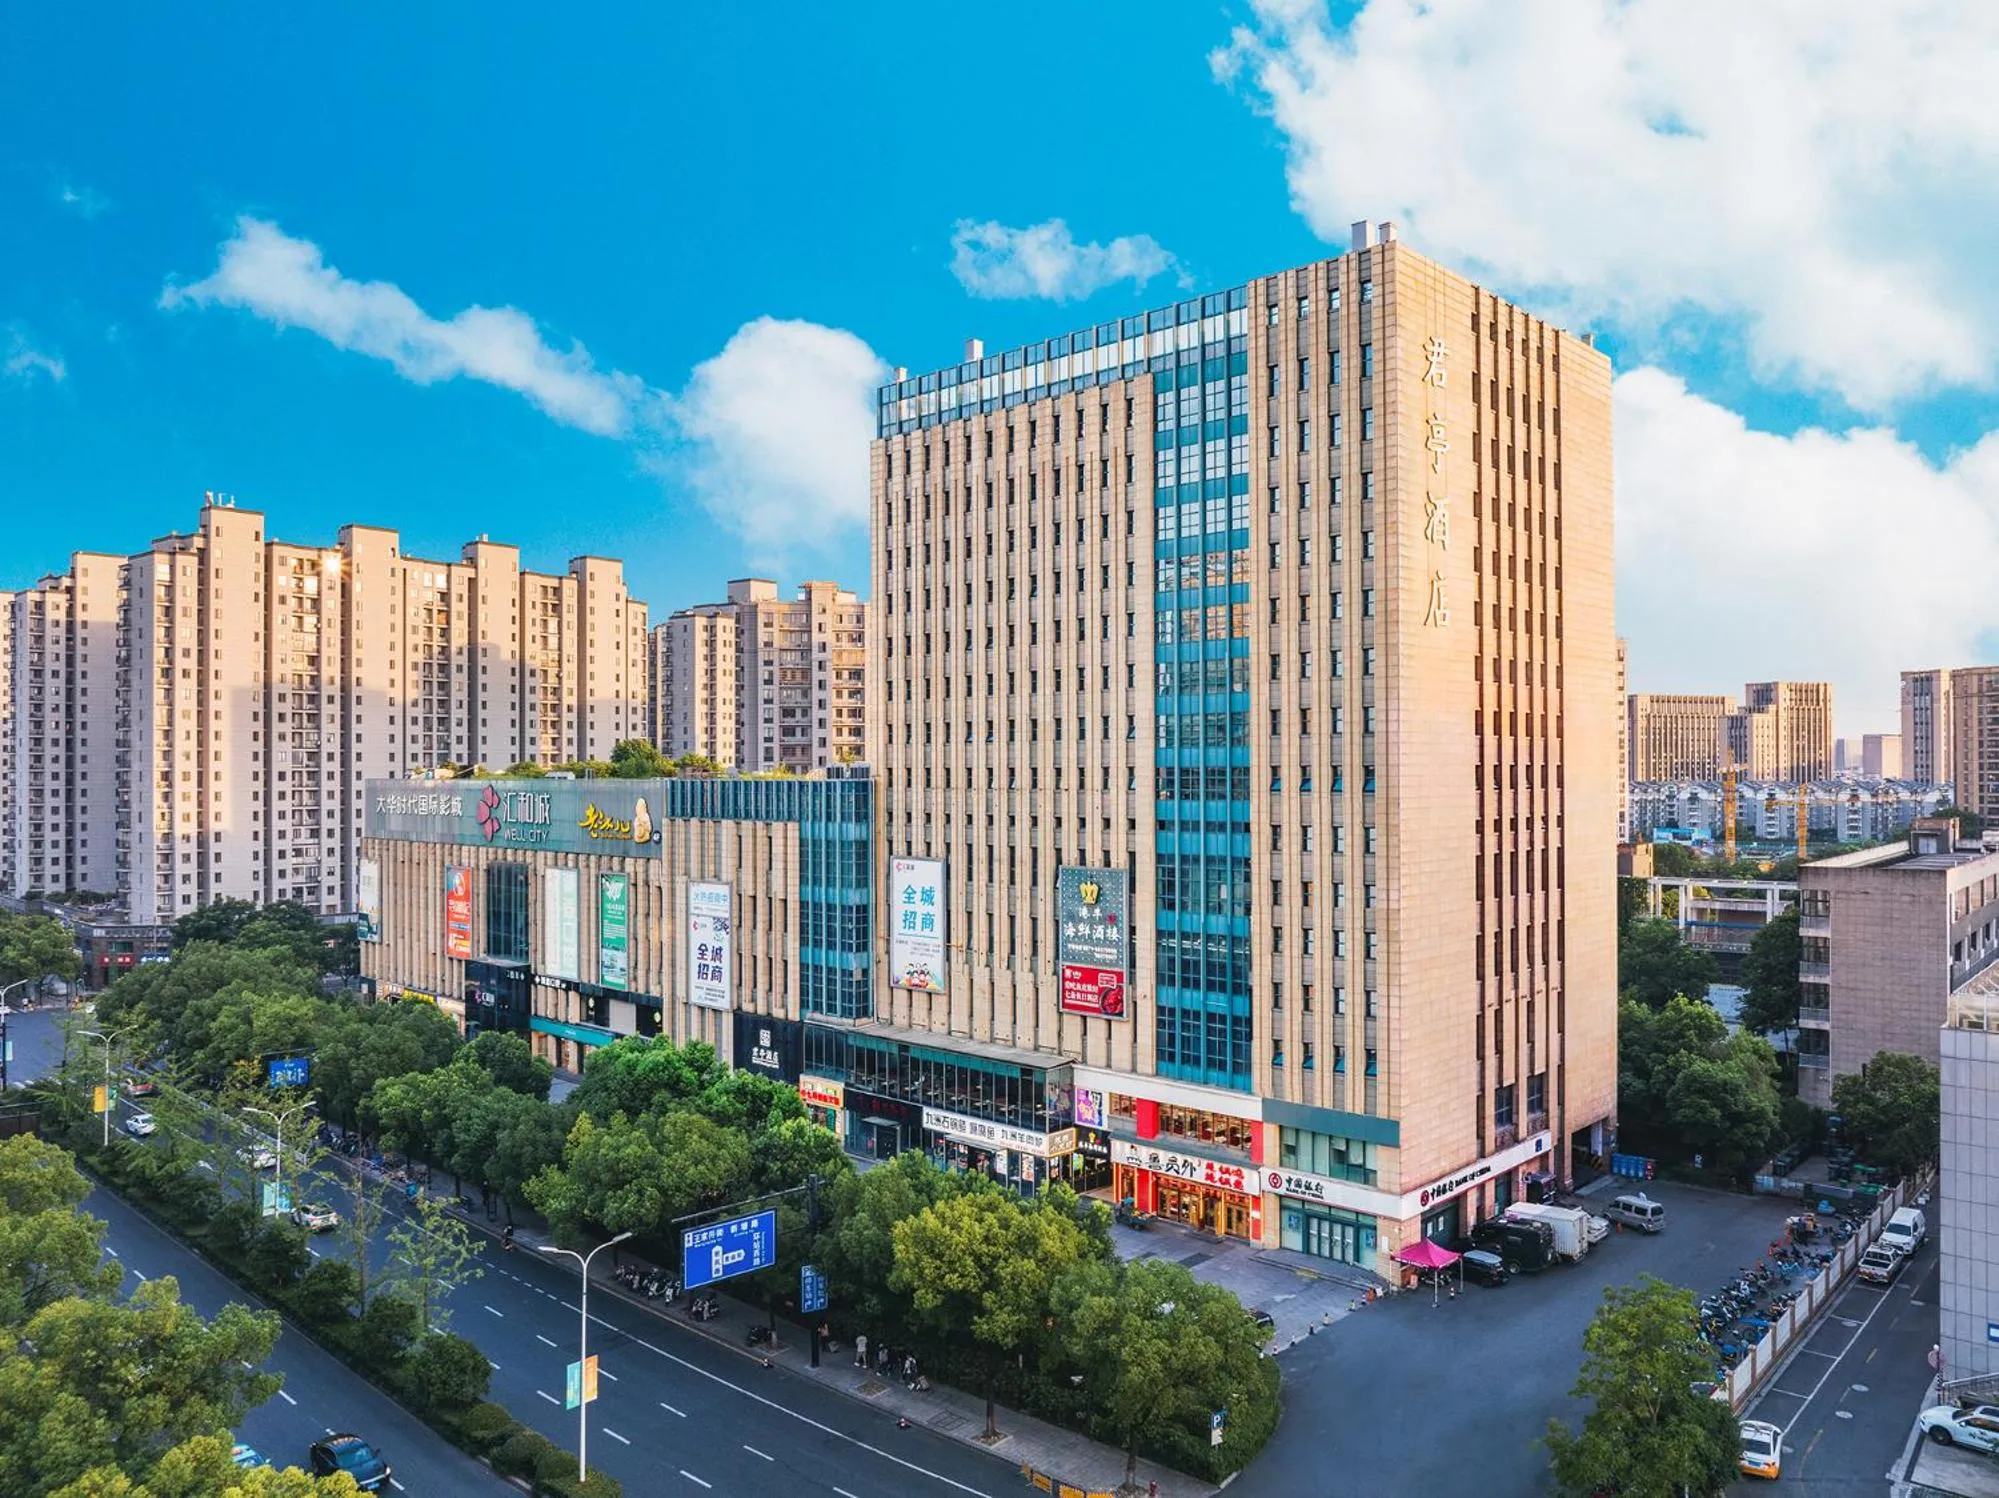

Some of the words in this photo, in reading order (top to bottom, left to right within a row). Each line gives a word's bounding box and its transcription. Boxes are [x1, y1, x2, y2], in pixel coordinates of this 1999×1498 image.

[376, 792, 463, 817] 大华时代国际影城
[503, 791, 551, 825] 汇和城
[529, 829, 549, 843] CITY
[902, 884, 936, 906] 全城
[902, 910, 935, 932] 招商
[1063, 922, 1122, 942] 海鲜酒楼
[697, 962, 723, 983] 招商
[1285, 1176, 1325, 1195] 中国银行
[1213, 1414, 1221, 1428] P
